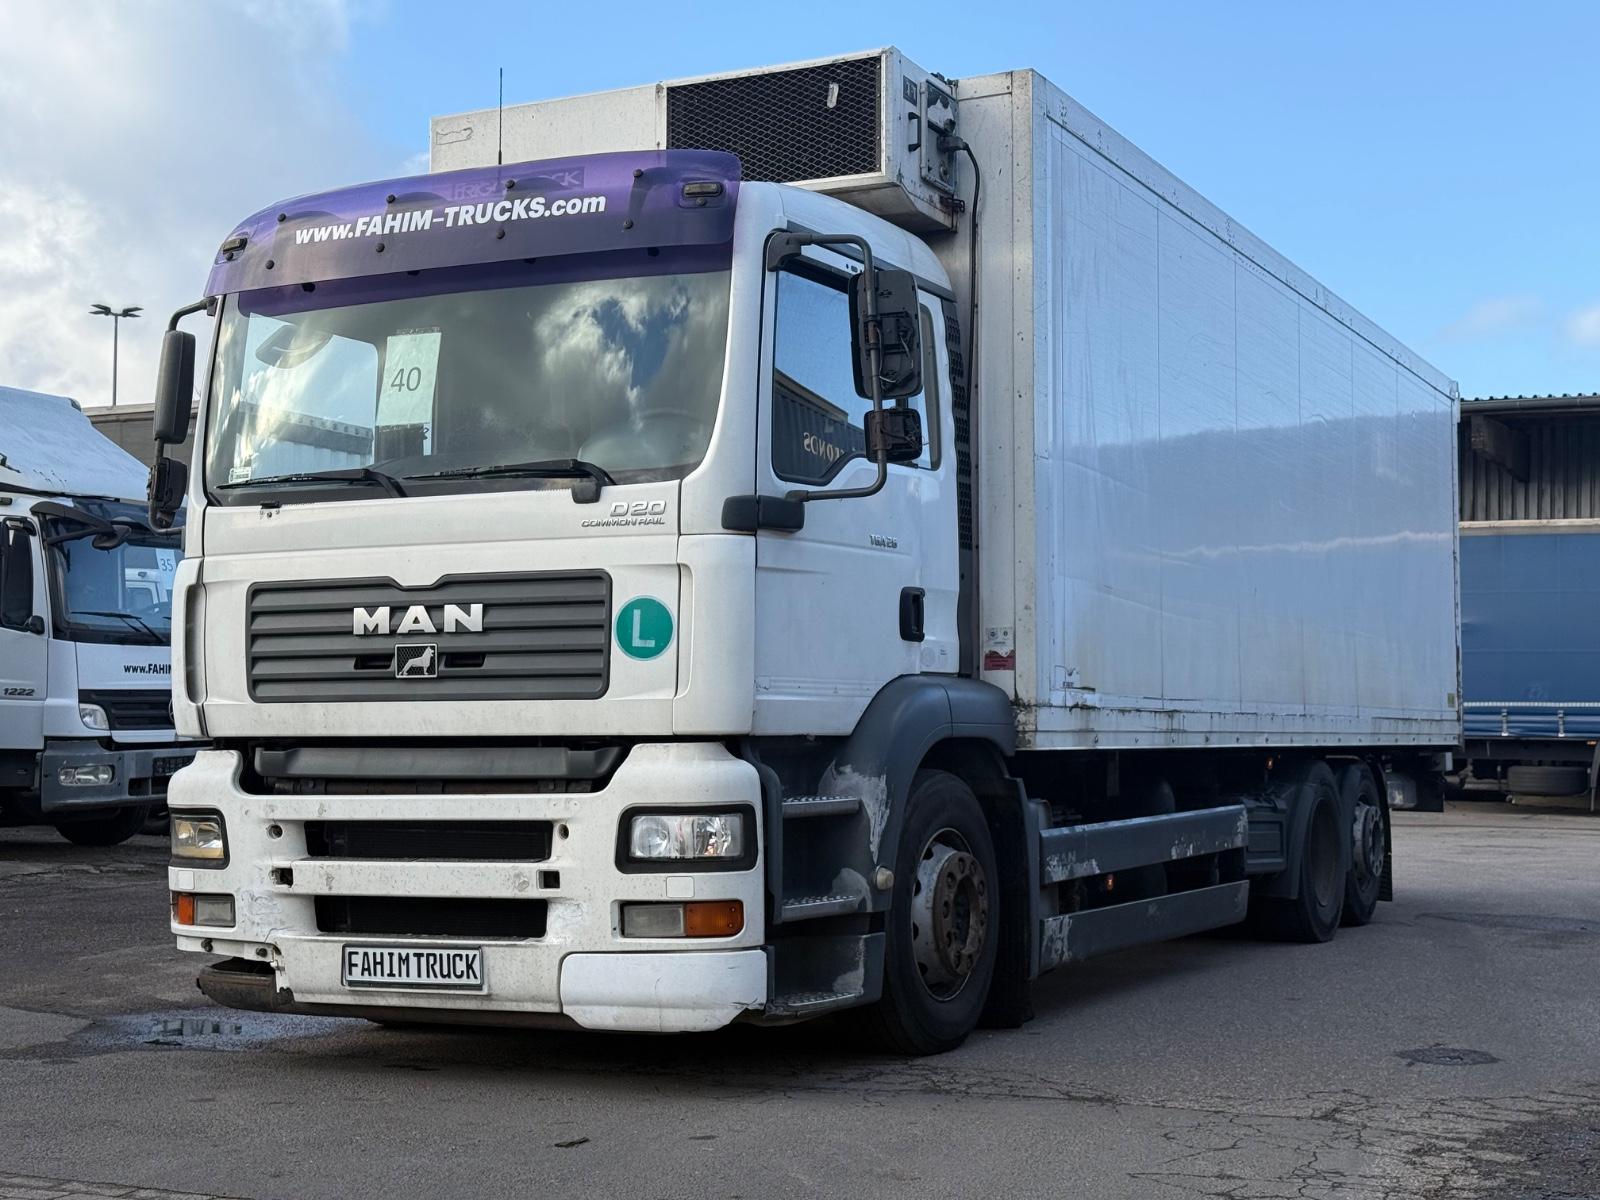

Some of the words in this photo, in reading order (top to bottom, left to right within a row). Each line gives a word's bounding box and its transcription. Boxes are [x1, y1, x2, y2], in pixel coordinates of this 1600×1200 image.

[294, 195, 607, 245] www.FAHIM-TRUCKS.com
[391, 366, 421, 392] 40
[609, 501, 667, 517] D20
[581, 518, 637, 527] COMMON
[638, 517, 665, 526] RAIL
[160, 558, 174, 572] 35
[353, 603, 484, 635] MAN
[632, 608, 656, 648] L
[3, 687, 36, 697] 1222
